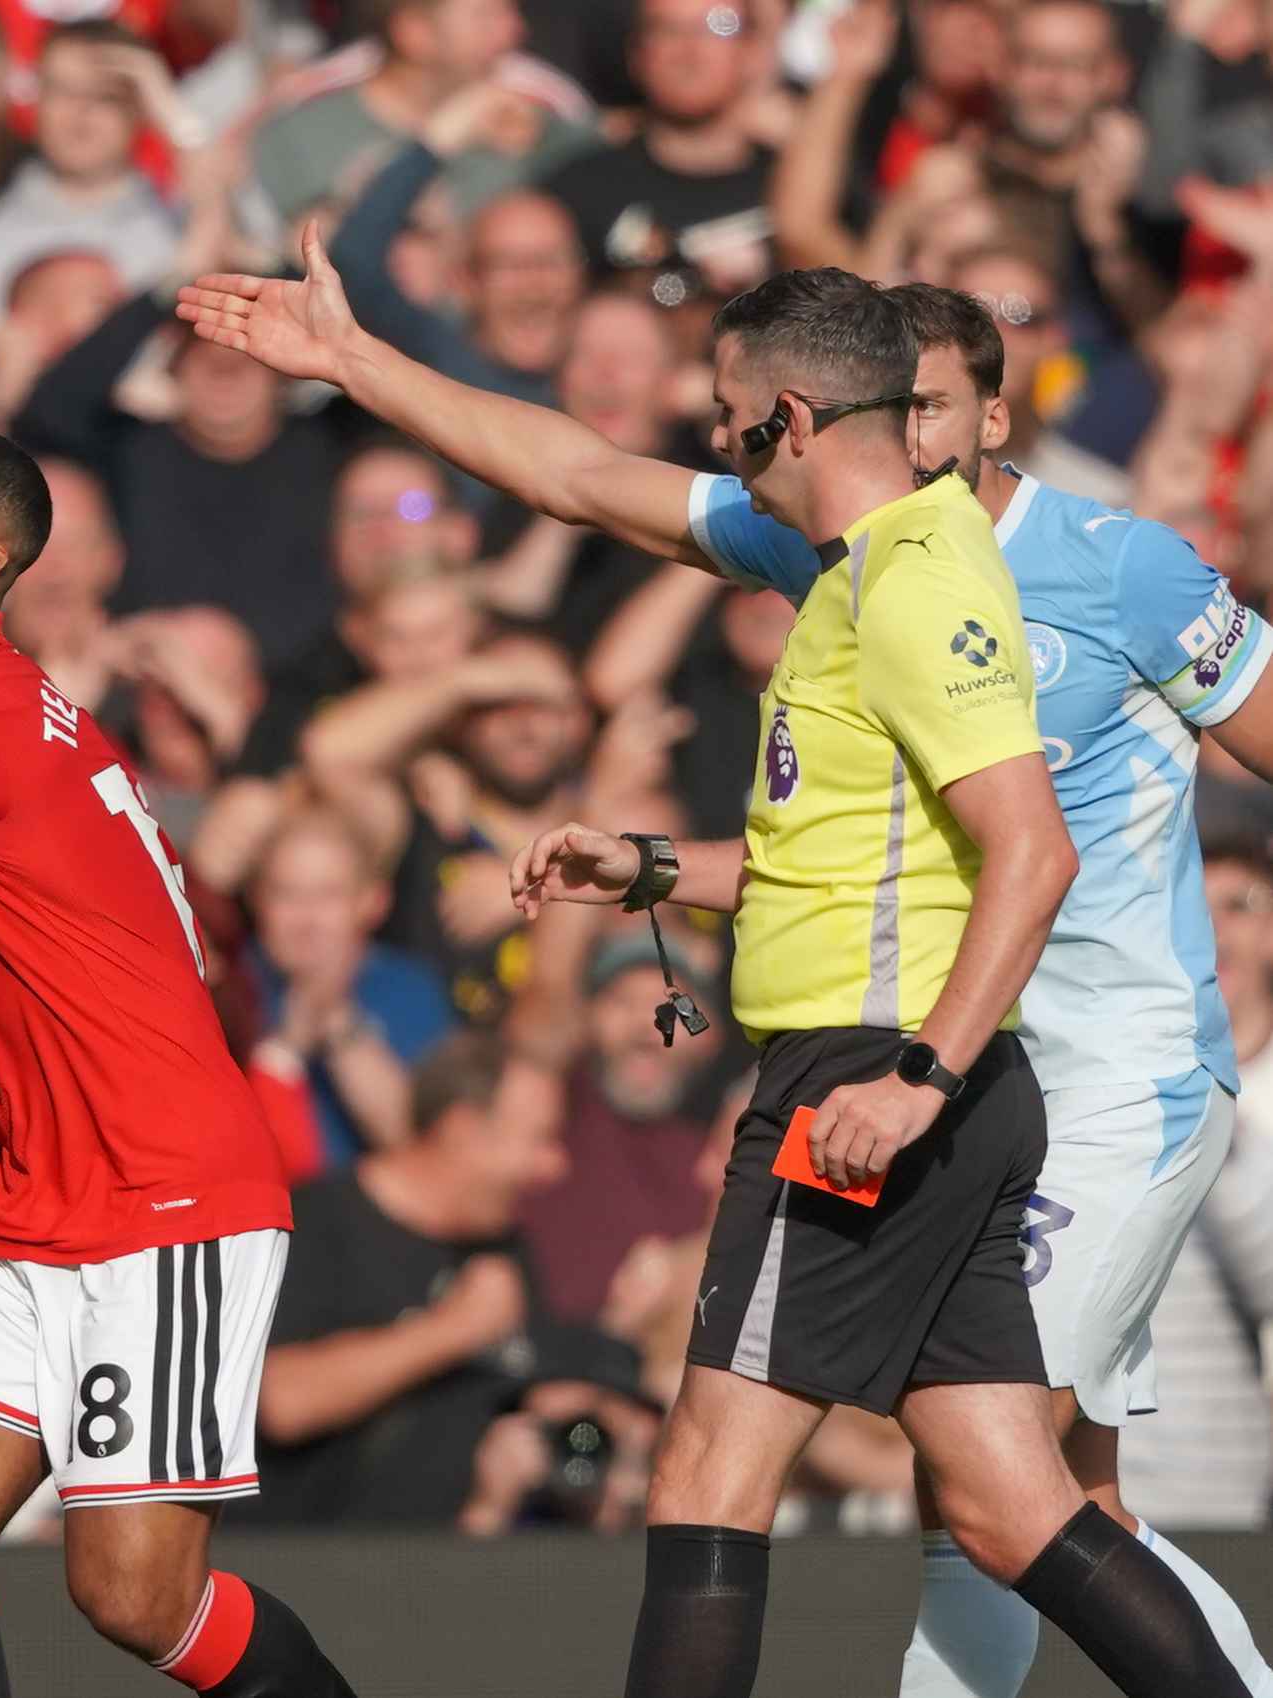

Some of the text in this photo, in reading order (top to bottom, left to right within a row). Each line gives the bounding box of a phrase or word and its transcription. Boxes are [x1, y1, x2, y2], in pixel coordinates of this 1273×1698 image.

[953, 694, 997, 715] Building
[1022, 1193, 1076, 1289] 3
[66, 1363, 135, 1466] 8
